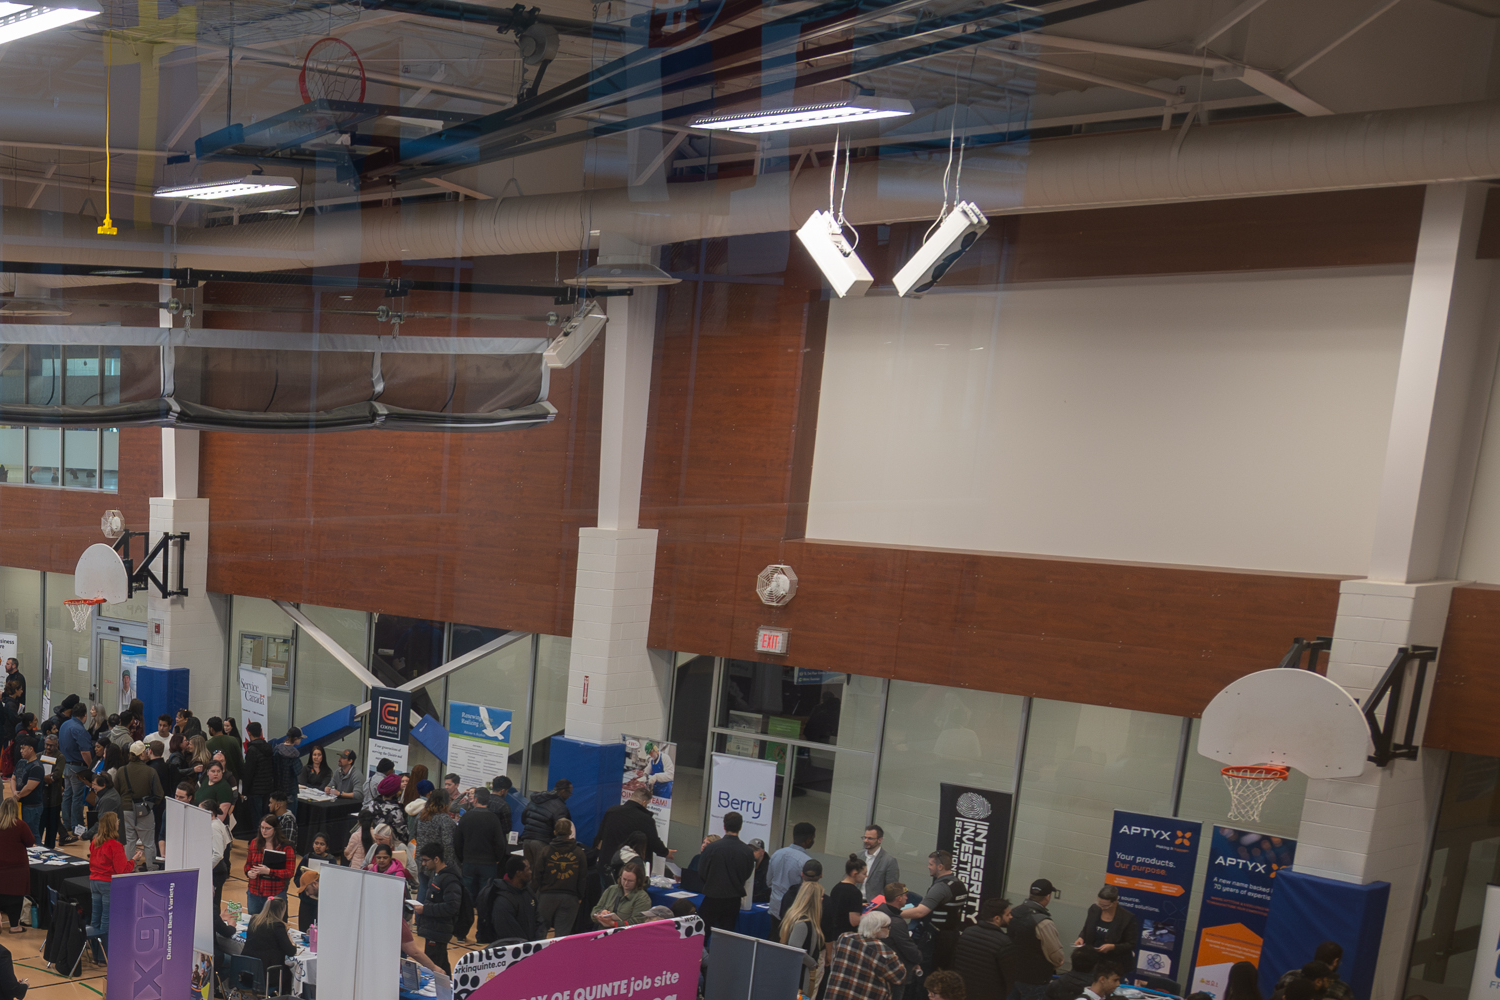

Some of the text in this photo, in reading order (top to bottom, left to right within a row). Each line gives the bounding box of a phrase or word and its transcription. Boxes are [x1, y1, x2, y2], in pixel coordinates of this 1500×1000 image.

[762, 633, 779, 649] EXIT
[241, 678, 259, 692] Service
[245, 692, 265, 705] Canada
[380, 724, 397, 732] COONEY
[650, 798, 668, 807] TEAM!
[718, 791, 762, 819] Berry
[1119, 825, 1171, 840] APTYX
[957, 822, 975, 905] INVESTIG
[1114, 860, 1167, 876] Our purpose.
[1116, 852, 1176, 869] Your products.
[1215, 856, 1267, 874] APTYX
[966, 824, 989, 924] INTEGRITY
[1222, 886, 1239, 894] years
[1232, 880, 1248, 888] name
[1250, 884, 1270, 893] backed
[1135, 904, 1160, 913] solutions.
[135, 883, 167, 953] 97
[455, 961, 506, 974] orkinquinte.ca
[629, 977, 651, 997] job
[654, 971, 679, 987] site
